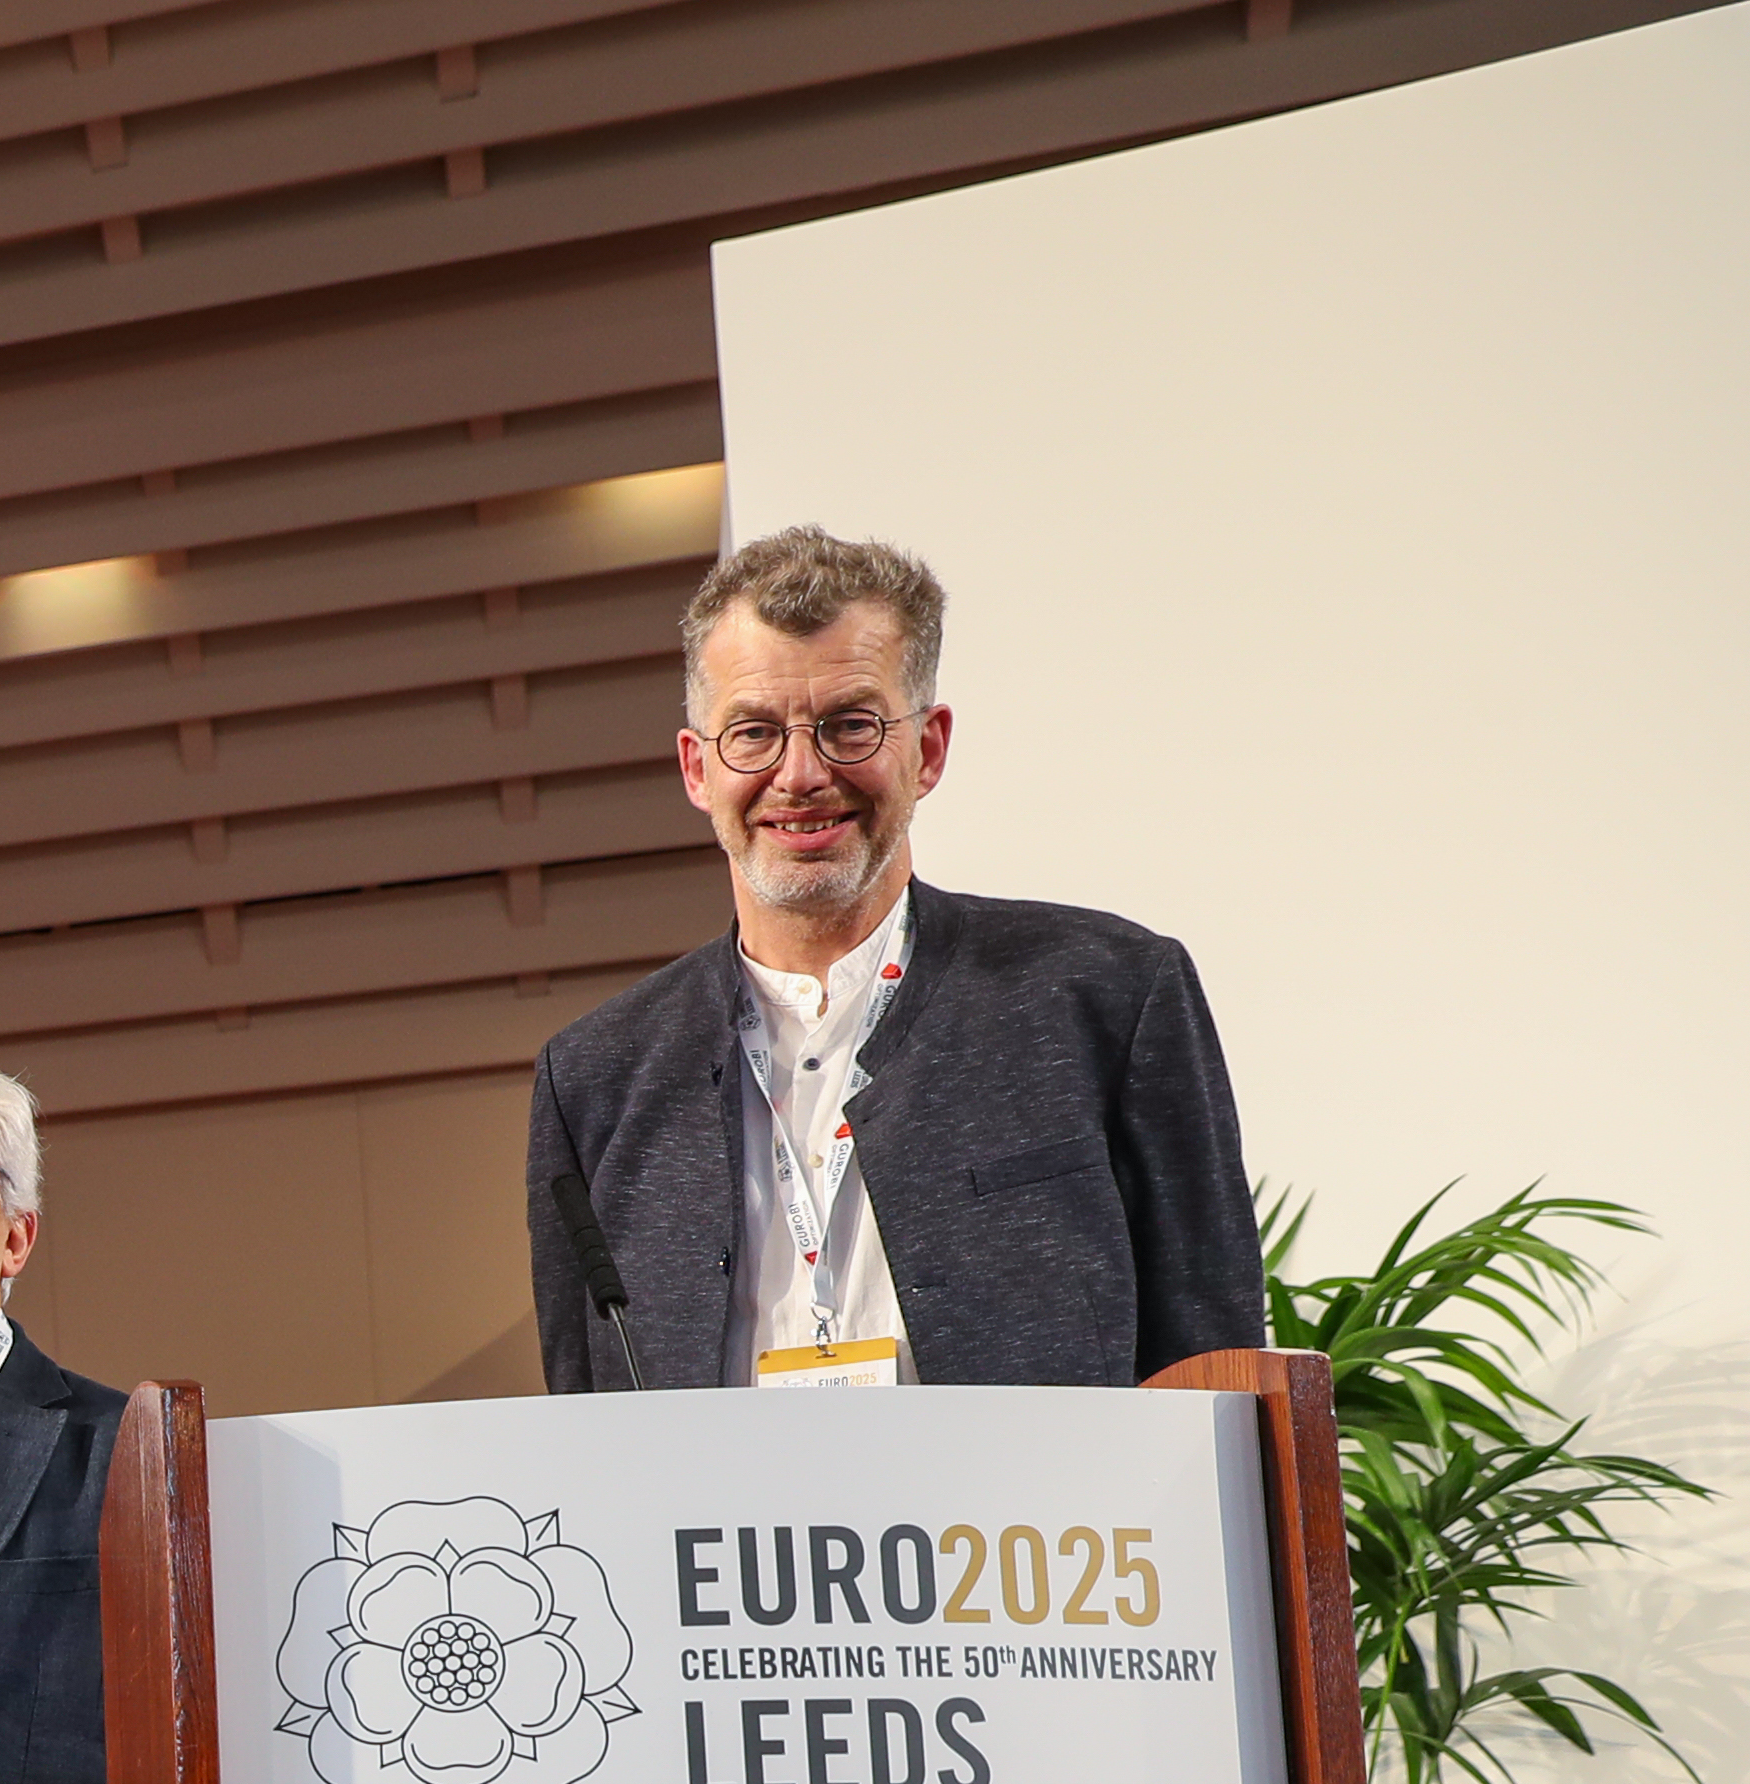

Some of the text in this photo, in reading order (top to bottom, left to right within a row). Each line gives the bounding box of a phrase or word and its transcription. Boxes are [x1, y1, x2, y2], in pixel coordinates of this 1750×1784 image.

[788, 1203, 811, 1247] GUROBI
[673, 1523, 1162, 1627] EURO2025
[680, 1645, 1218, 1682] CELEBRATING THE 50th ANNIVERSARY
